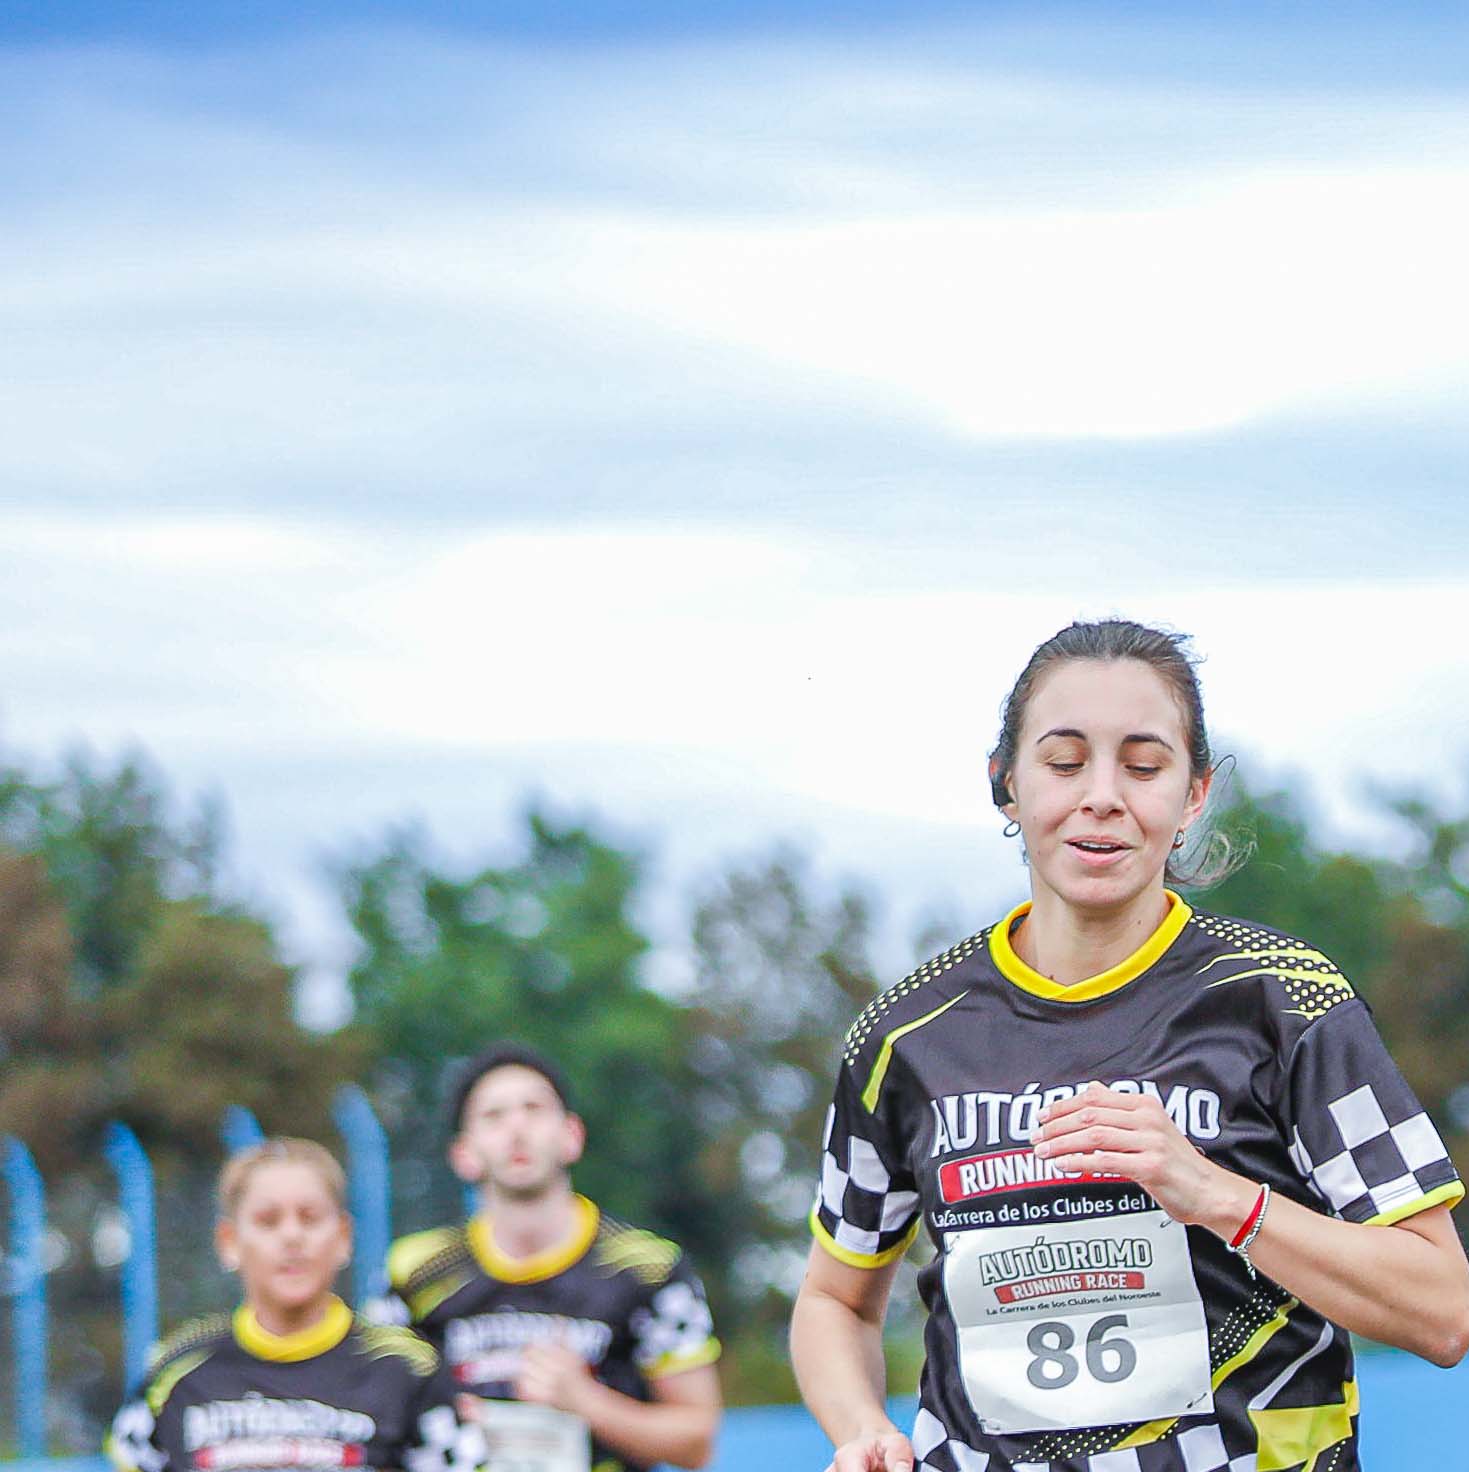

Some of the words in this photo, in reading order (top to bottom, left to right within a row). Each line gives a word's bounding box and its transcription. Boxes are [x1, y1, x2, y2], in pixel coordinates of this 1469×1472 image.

[930, 1079, 1221, 1158] AUTÓMO
[959, 1149, 1084, 1197] RUNNIN
[998, 1204, 1020, 1222] de
[1023, 1202, 1050, 1219] los
[1053, 1197, 1114, 1216] Clubes
[1118, 1194, 1146, 1211] del
[979, 1235, 1153, 1286] AUTÓDROMO
[986, 1308, 998, 1316] La
[1000, 1305, 1036, 1315] Carrera
[1037, 1302, 1050, 1310] de
[1052, 1300, 1067, 1308] los
[1067, 1296, 1101, 1307] Clubes
[1102, 1293, 1118, 1304] del
[1118, 1290, 1162, 1302] Noroeste
[1010, 1275, 1082, 1300] RUNNING
[1085, 1273, 1128, 1291] RACE
[1026, 1314, 1137, 1390] 86
